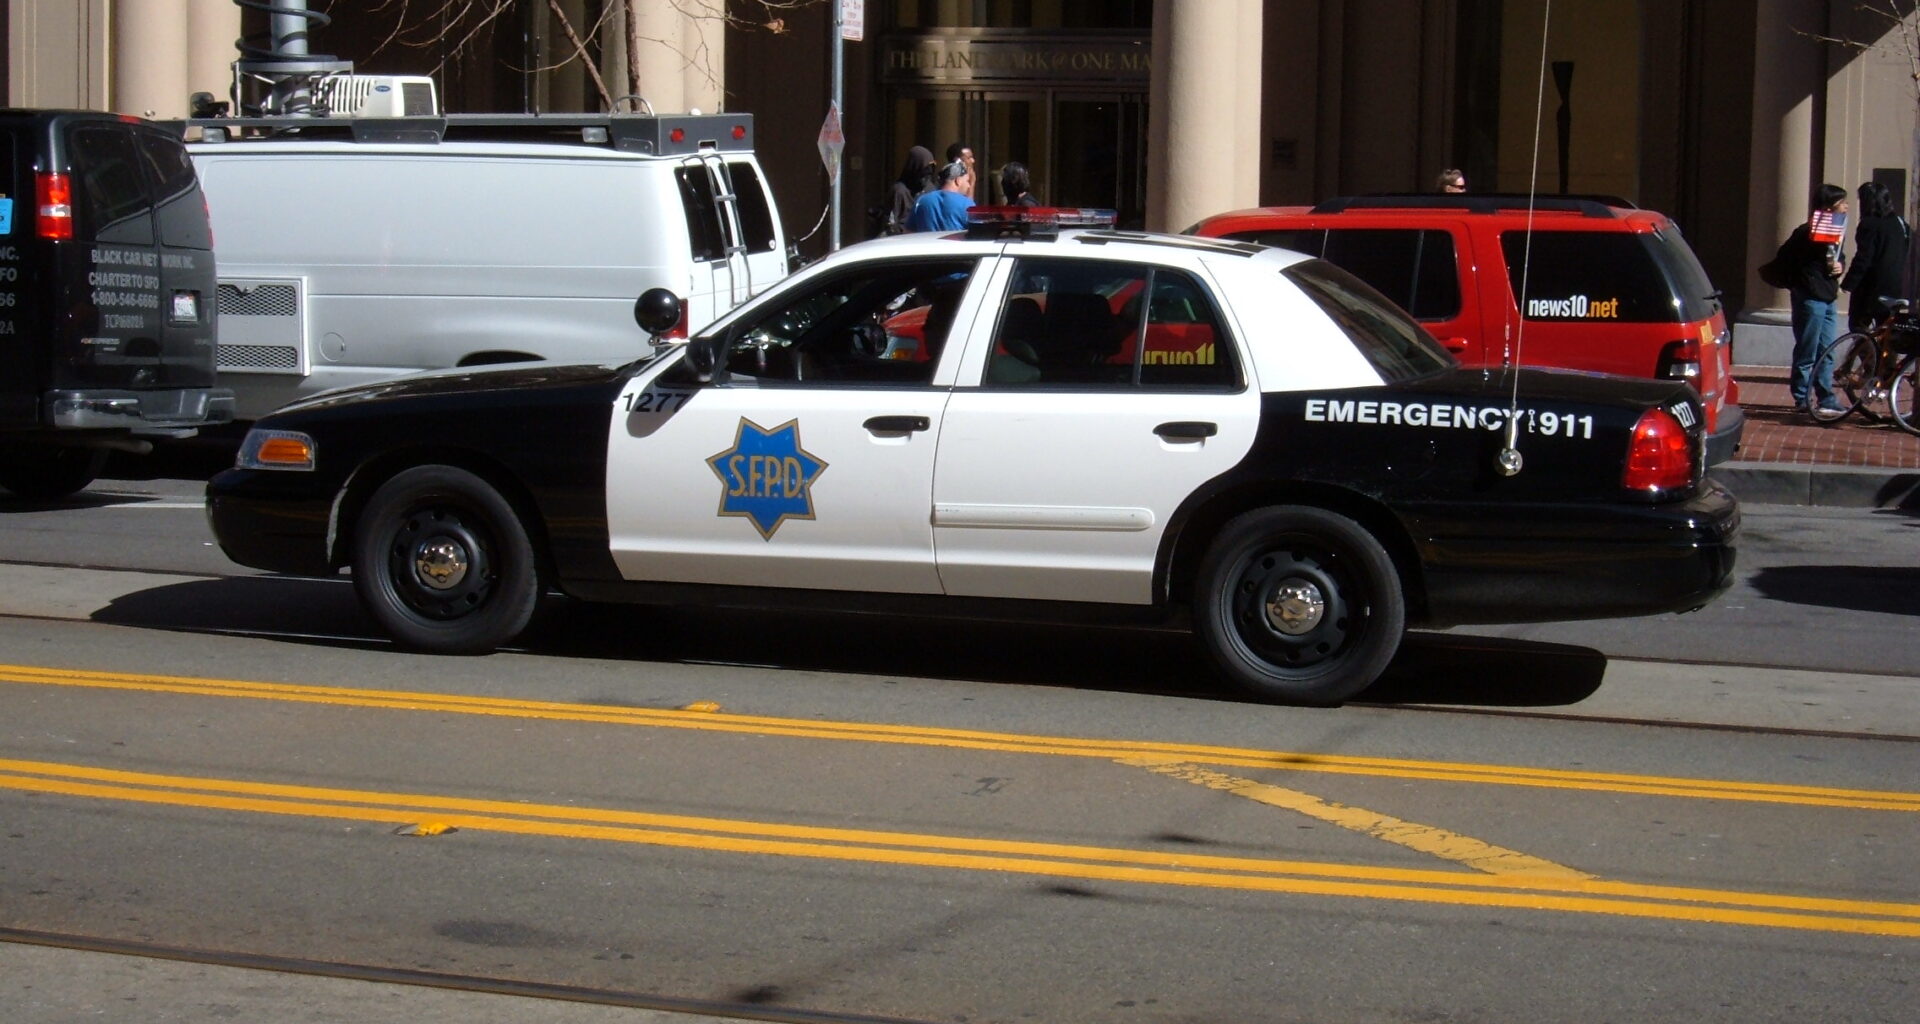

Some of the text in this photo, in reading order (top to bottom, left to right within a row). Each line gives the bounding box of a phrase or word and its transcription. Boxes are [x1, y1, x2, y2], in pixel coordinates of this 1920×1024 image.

[1071, 52, 1115, 71] ONE
[91, 249, 122, 264] BLACK
[124, 250, 142, 266] CAR
[88, 271, 159, 290] CHARTER TO SFO
[1528, 294, 1619, 319] news10.net
[622, 392, 692, 414] 1277
[1304, 398, 1525, 432] EMERGENCY
[1539, 412, 1594, 440] 911
[728, 454, 804, 499] S.F.P.D.
